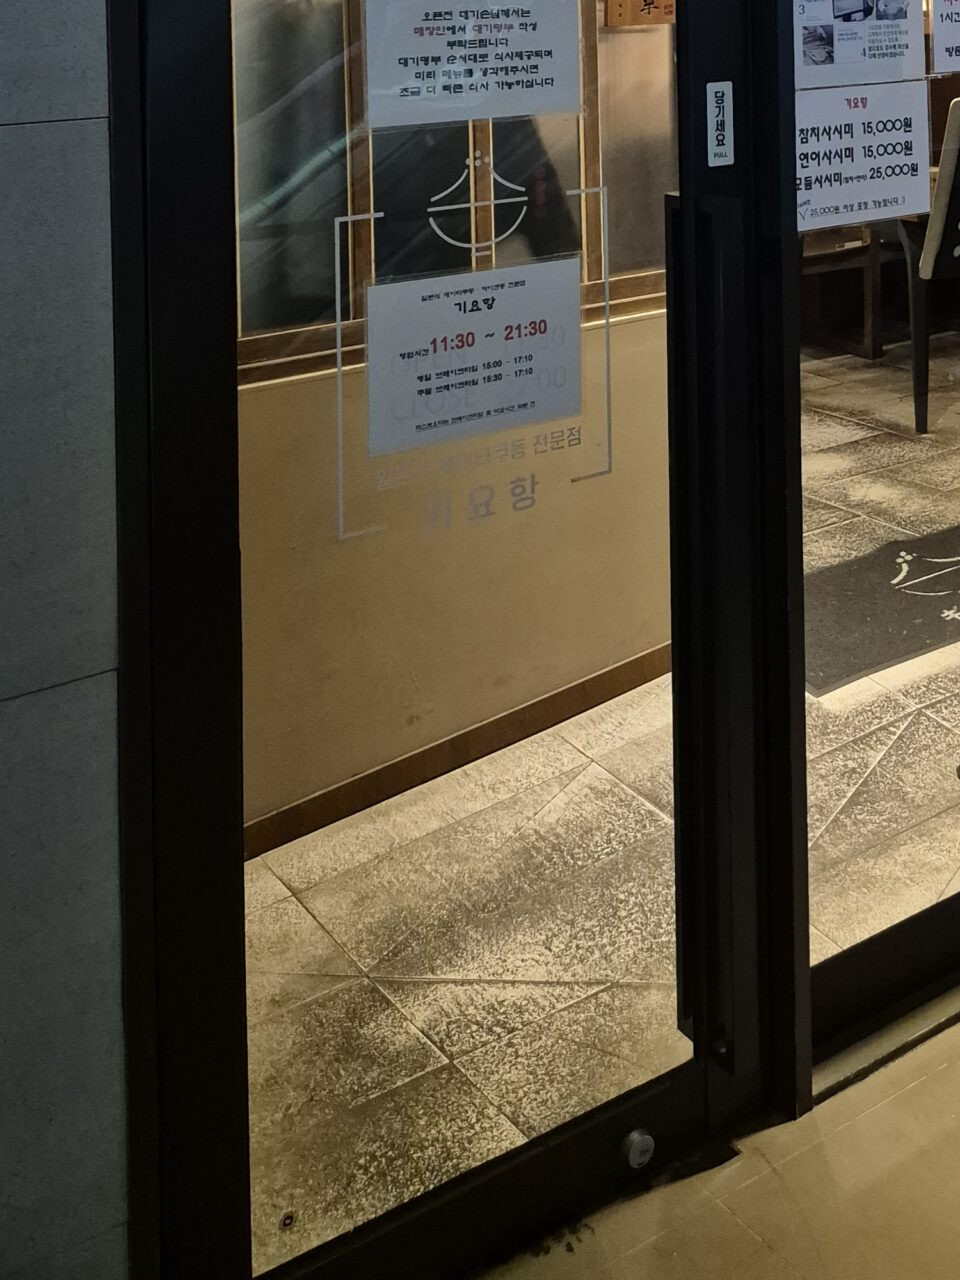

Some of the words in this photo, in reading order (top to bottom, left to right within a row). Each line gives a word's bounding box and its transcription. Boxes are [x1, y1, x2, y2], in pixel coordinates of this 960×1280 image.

[421, 11, 453, 21] 오픈전
[458, 8, 532, 20] 대기손님께서는
[413, 25, 467, 36] 매장안에서
[471, 23, 514, 34] 대기명부
[518, 22, 538, 32] 작성
[446, 37, 509, 50] 부탁드립니다
[397, 56, 442, 67] 대기명부
[446, 53, 489, 65] 순서대로
[494, 49, 553, 61] 식사제공되며
[414, 70, 436, 81] 미리
[441, 67, 473, 79] 메뉴를
[478, 64, 539, 77] 생각해주시면
[398, 86, 421, 97] 조금
[426, 84, 436, 95] 더
[441, 83, 464, 94] 빠른
[468, 80, 490, 92] 식사
[494, 77, 555, 91] 가능하십니다
[844, 97, 868, 110] 기요항
[714, 90, 726, 148] 당기세요
[798, 122, 854, 145] 참치사시미
[861, 116, 913, 136] 15,000원
[713, 150, 728, 159] PULL
[798, 146, 854, 169] 연어사시미
[862, 140, 913, 160] 15,000원
[794, 171, 843, 192] 모듬사시미
[869, 162, 919, 181] 25,000원
[453, 296, 496, 314] 기요항
[399, 348, 430, 361] 영업시간
[429, 331, 476, 354] 11:30
[504, 319, 548, 342] 21:30
[435, 364, 479, 380] 브레이크타임
[513, 353, 534, 365] 17:10
[435, 377, 479, 394] 브레이크타임
[513, 366, 534, 378] 17:10
[532, 425, 582, 455] 전문점
